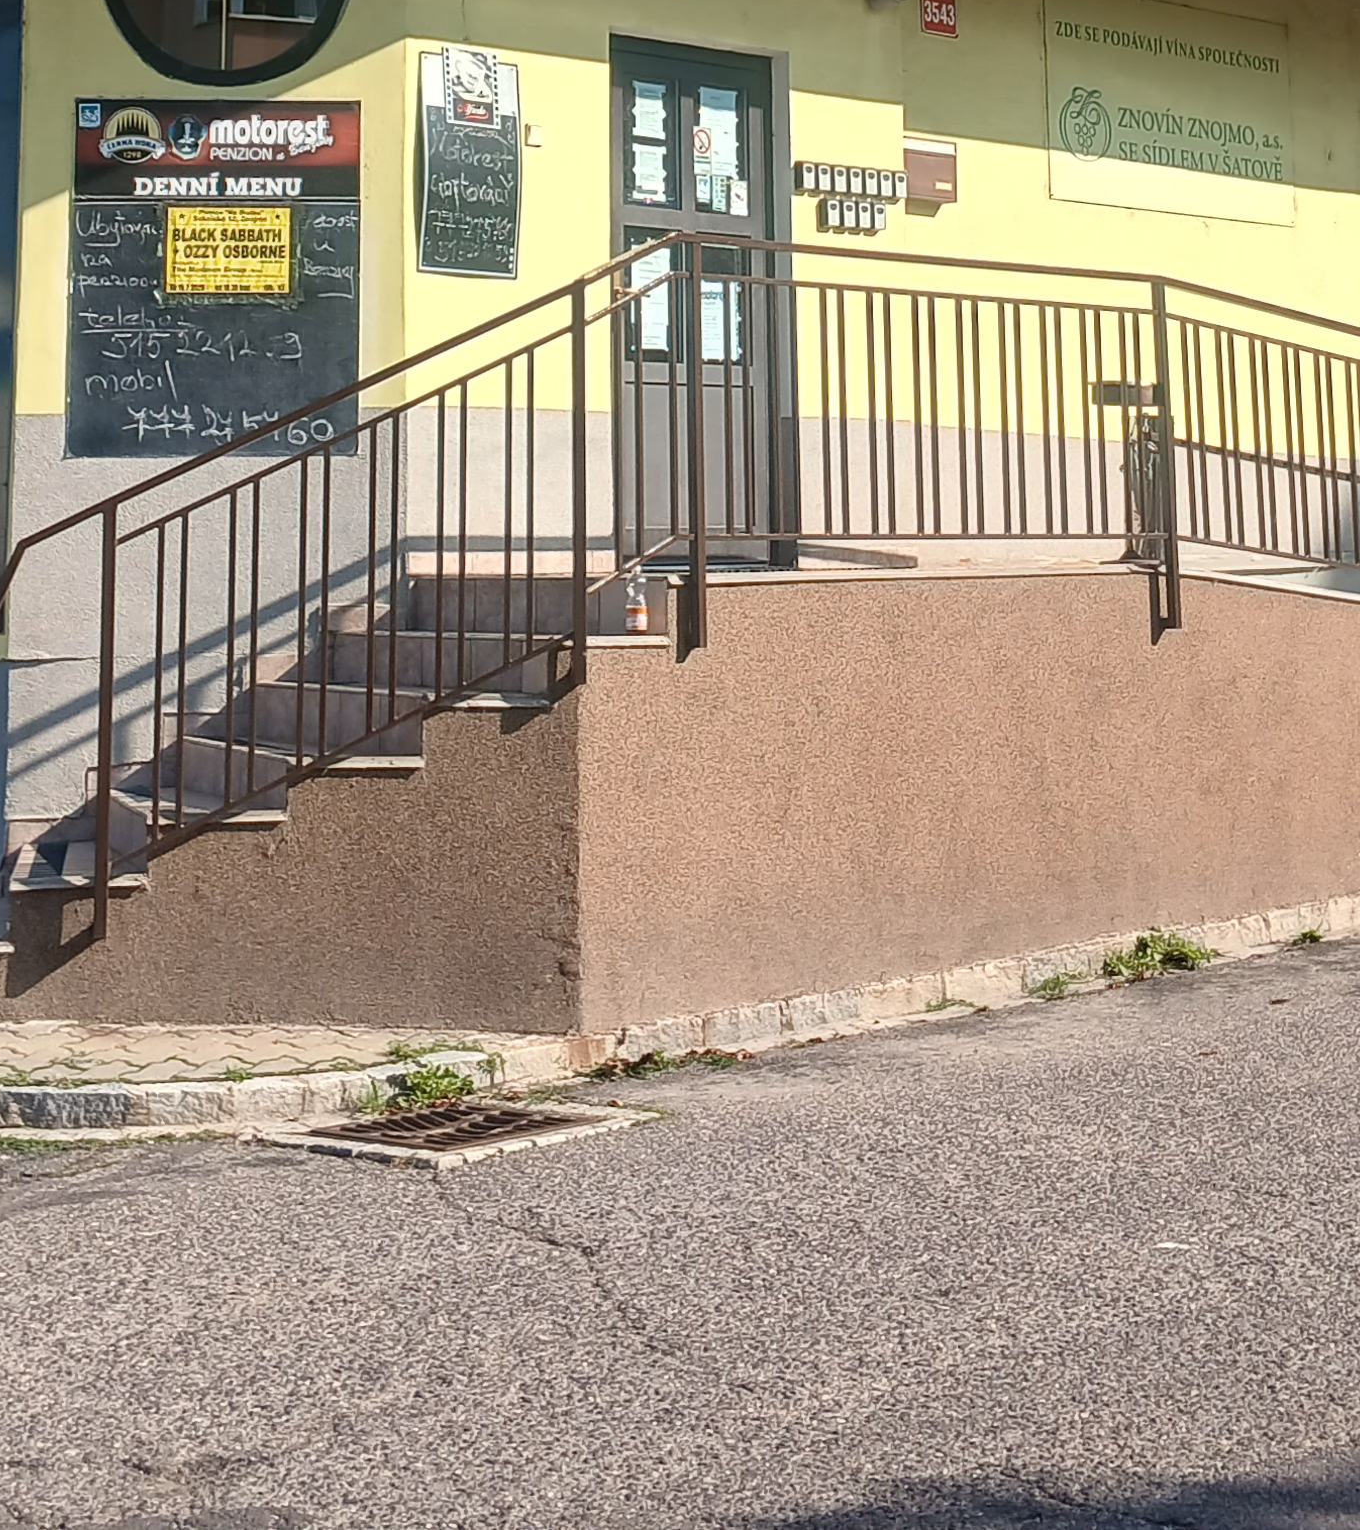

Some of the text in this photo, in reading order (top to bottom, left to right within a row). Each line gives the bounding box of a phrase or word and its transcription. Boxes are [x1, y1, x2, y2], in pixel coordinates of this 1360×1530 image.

[924, 0, 956, 26] 3543
[1055, 21, 1280, 74] ZDE SE PODÁVAJÍ VÍNA SPOLEČNOSTI
[209, 114, 331, 145] motorest
[1117, 107, 1283, 151] ZNOVÍN ZNOJMO, a.s.
[210, 147, 273, 161] PENZION
[1118, 139, 1283, 182] SE SÍDLEM V ŠATOVĚ
[133, 172, 302, 196] DENNÍ MENU
[173, 227, 282, 242] BLACK SABBATH
[183, 244, 219, 259] OZZY
[222, 244, 286, 259] OSBORNE
